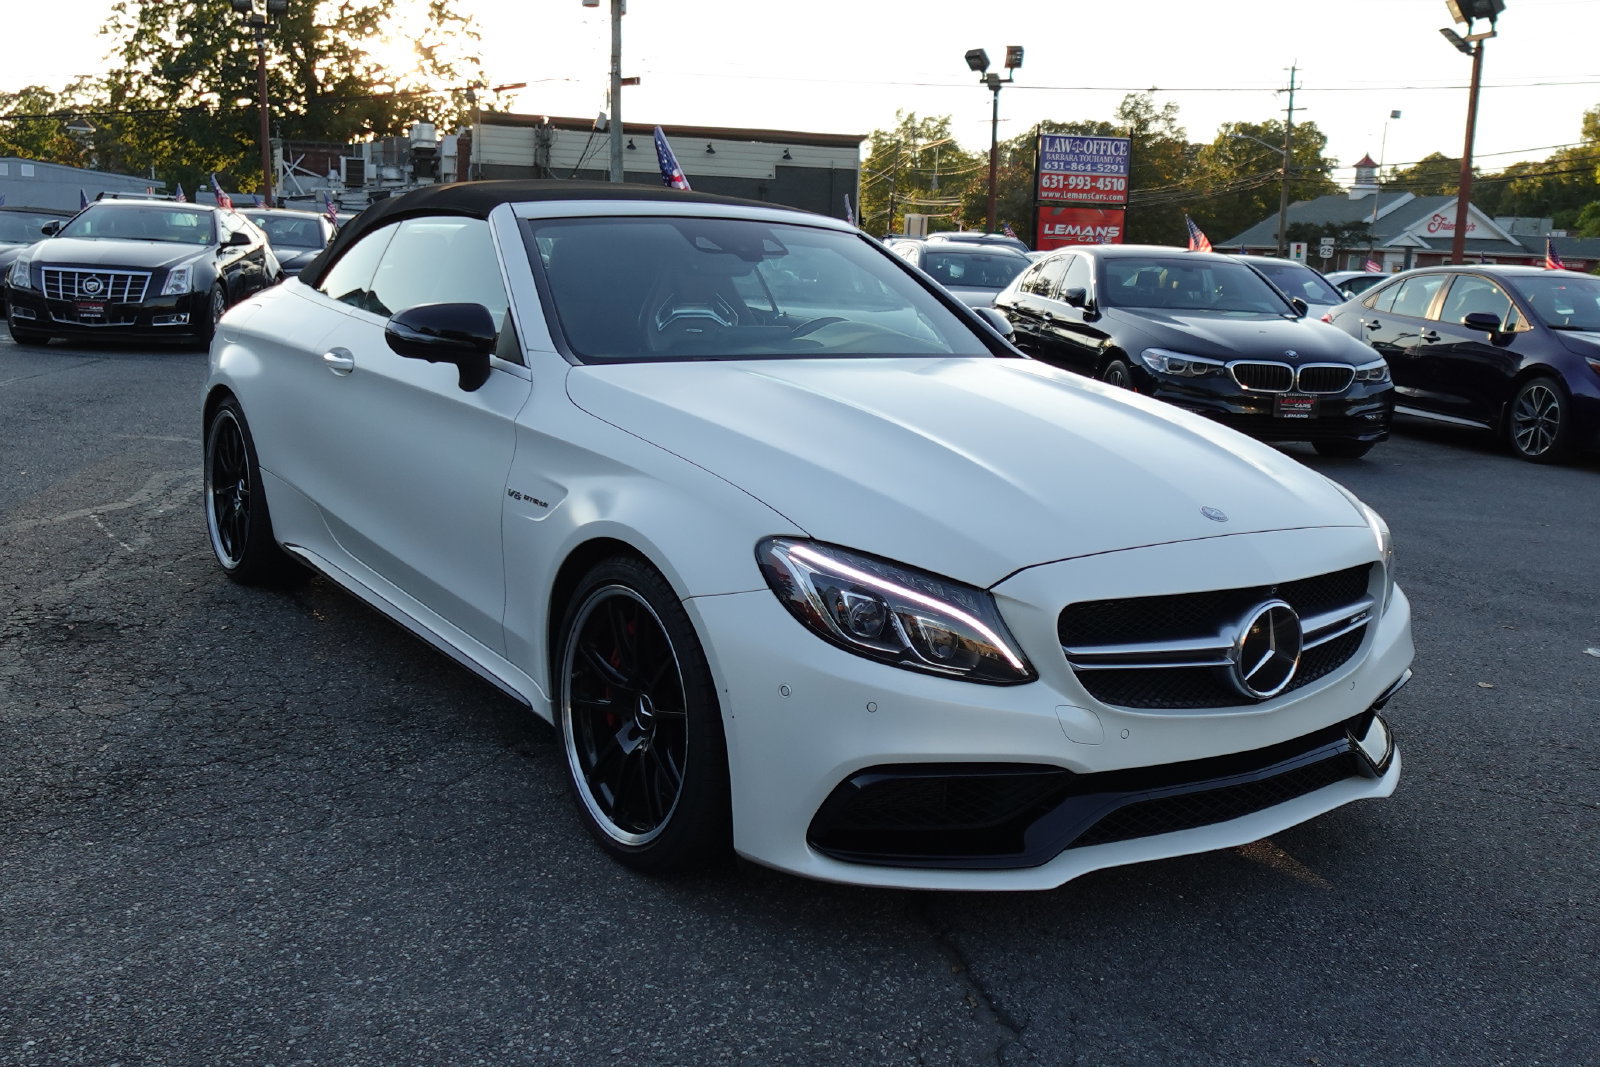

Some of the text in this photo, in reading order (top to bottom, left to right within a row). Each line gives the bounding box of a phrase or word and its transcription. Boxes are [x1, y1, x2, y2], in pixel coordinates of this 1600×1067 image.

[1045, 137, 1128, 155] LAW OFFICE
[1046, 152, 1078, 162] BARBARA
[1044, 162, 1124, 172] 631-864-5291
[1041, 174, 1125, 191] 631-993-4510
[1041, 190, 1124, 201] www.LemansCars.com
[1044, 223, 1121, 237] LEMANS
[1321, 248, 1332, 256] 25
